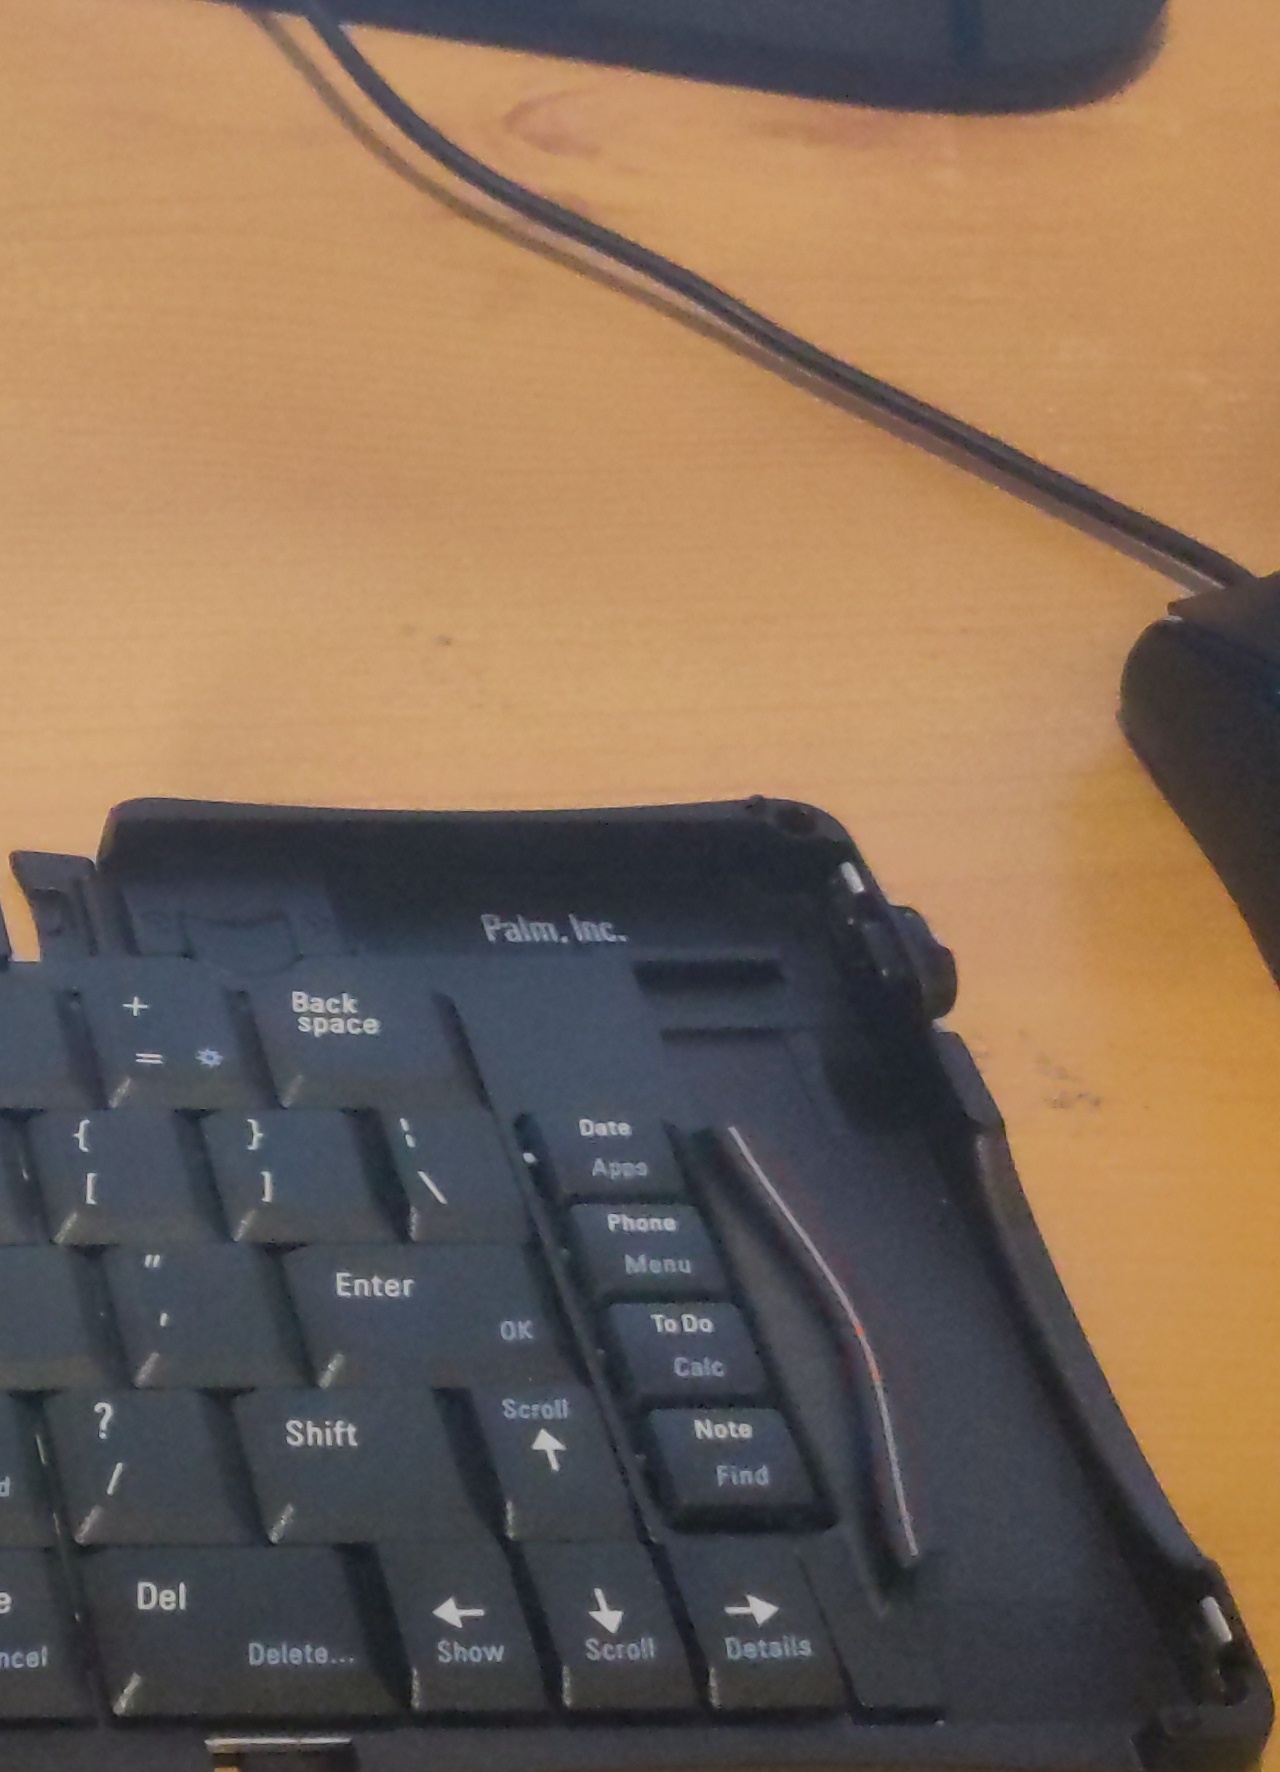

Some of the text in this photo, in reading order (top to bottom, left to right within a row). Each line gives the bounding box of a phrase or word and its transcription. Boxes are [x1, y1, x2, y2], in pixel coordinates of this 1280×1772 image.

[567, 914, 627, 942] Inc.
[123, 997, 148, 1016] +
[292, 991, 358, 1013] Back
[297, 1014, 380, 1037] space
[136, 1053, 162, 1064] =
[74, 1119, 90, 1152] {
[247, 1119, 263, 1150] }
[579, 1119, 631, 1136] Date
[86, 1173, 96, 1204] [
[262, 1171, 272, 1202] ]
[418, 1171, 446, 1203] \
[607, 1214, 676, 1232] Phone
[625, 1254, 691, 1273] Menu
[336, 1272, 414, 1297] Enter
[500, 1320, 533, 1341] OK
[674, 1357, 724, 1377] Calc
[94, 1402, 113, 1439] ?
[502, 1399, 569, 1419] Scroll
[286, 1420, 357, 1446] Shift
[694, 1419, 752, 1439] Note
[107, 1463, 123, 1494] /
[717, 1465, 769, 1486] Find
[138, 1582, 186, 1610] Del
[438, 1640, 504, 1663] Show
[584, 1638, 656, 1661] Scroll
[725, 1636, 812, 1660] Details
